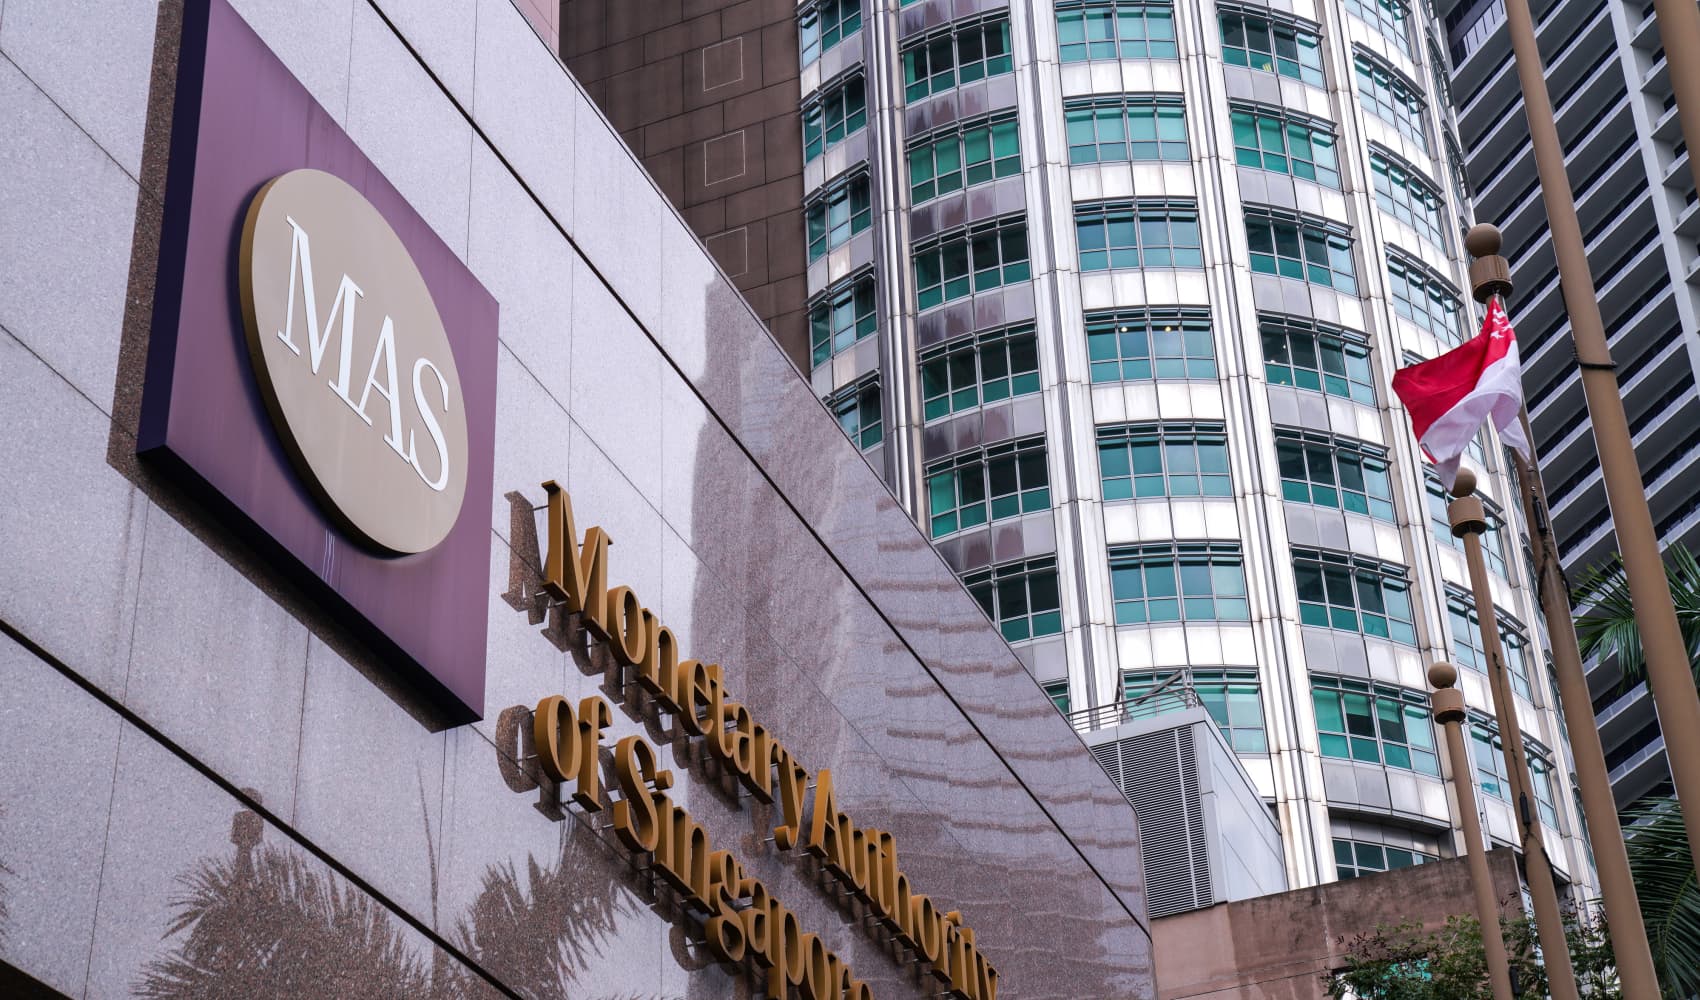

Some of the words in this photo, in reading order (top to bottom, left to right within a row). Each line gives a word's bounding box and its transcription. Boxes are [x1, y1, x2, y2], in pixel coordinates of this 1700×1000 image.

[277, 215, 449, 492] MAS
[541, 480, 811, 851] Monetary
[534, 694, 613, 812] of
[614, 735, 875, 1000] Singapor
